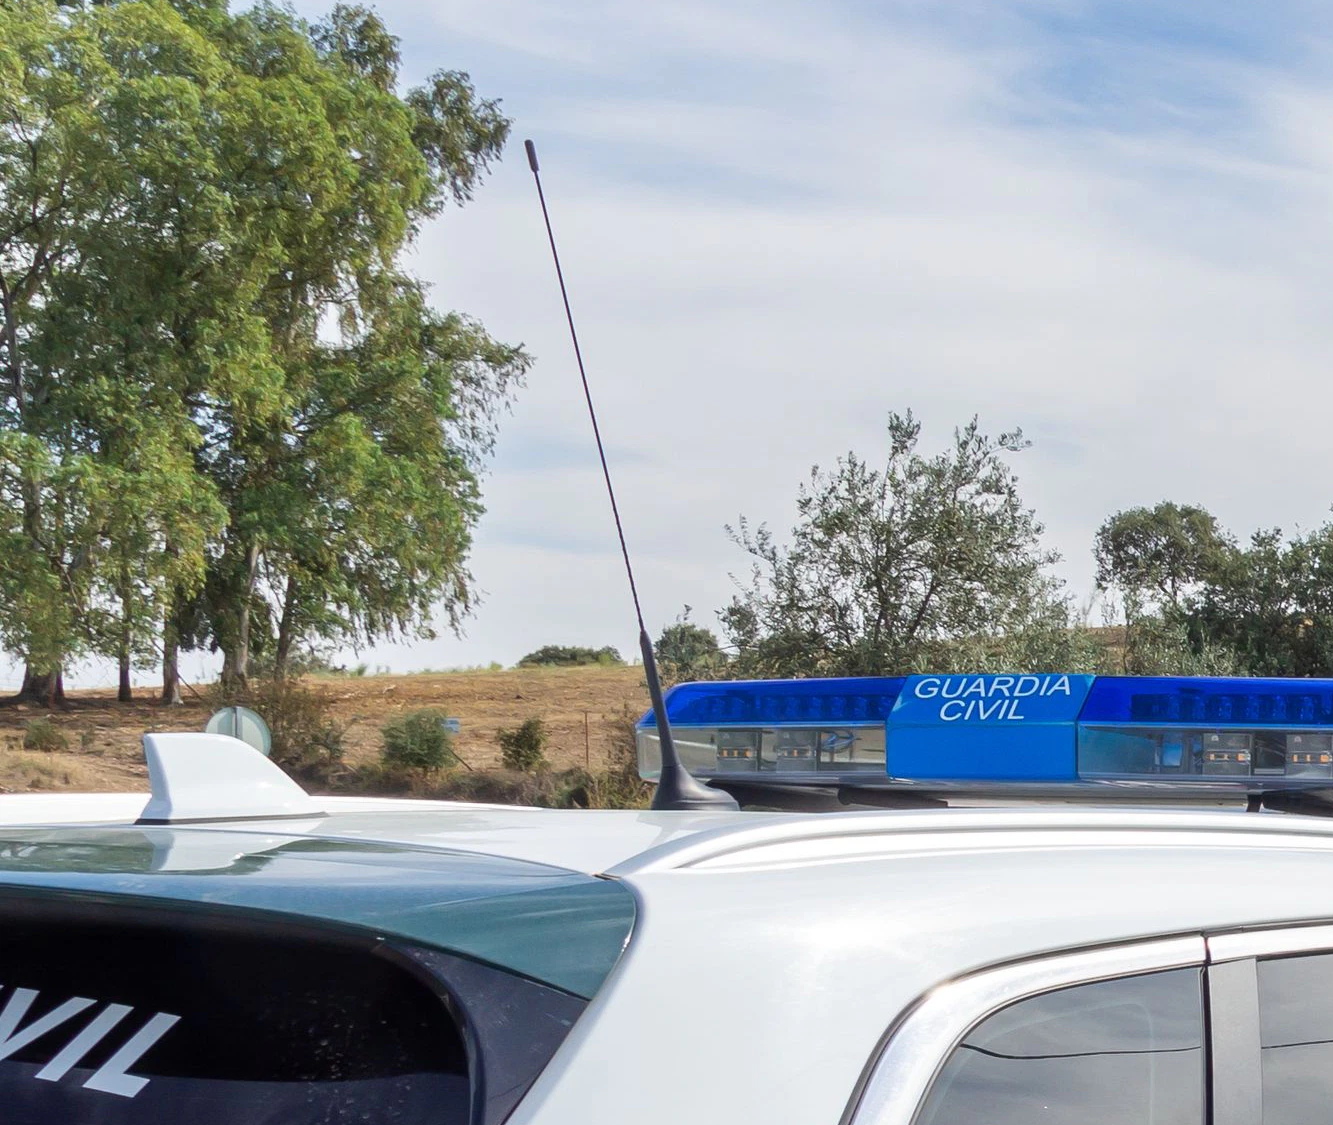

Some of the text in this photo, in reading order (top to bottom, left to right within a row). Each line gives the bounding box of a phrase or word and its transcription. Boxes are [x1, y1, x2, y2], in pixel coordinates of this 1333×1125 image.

[914, 675, 1072, 699] GUARDIA
[939, 699, 1025, 721] CIVIL
[0, 983, 182, 1098] VIL
